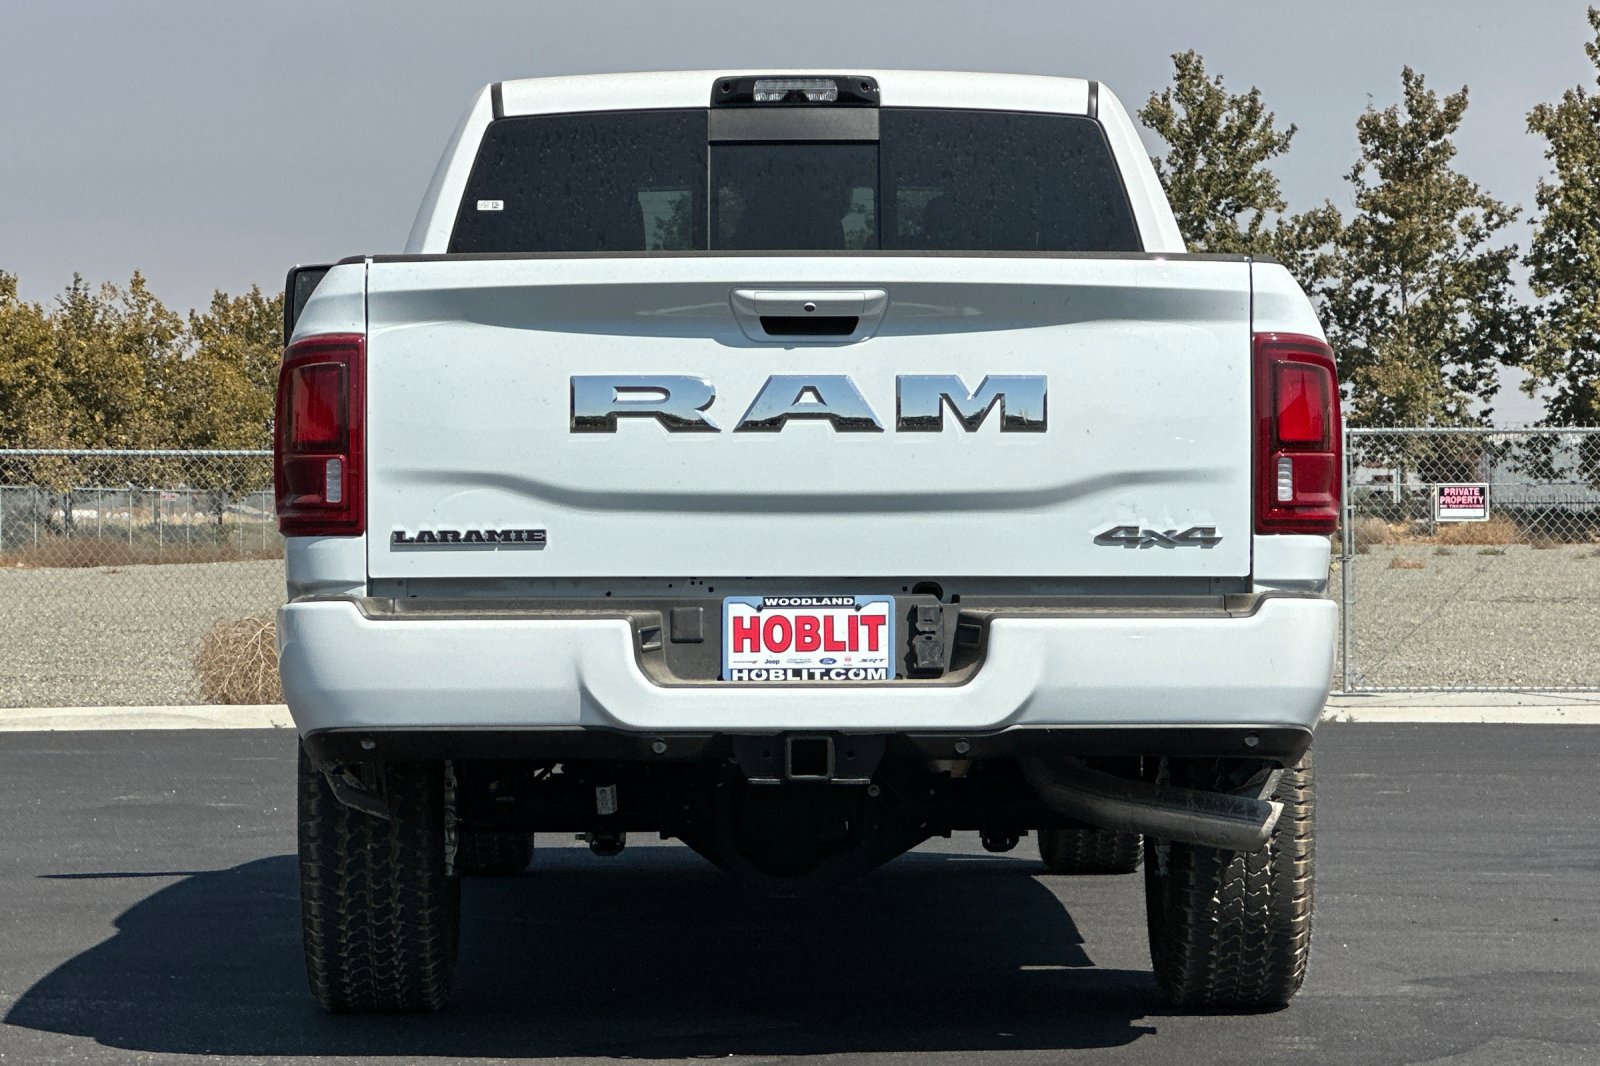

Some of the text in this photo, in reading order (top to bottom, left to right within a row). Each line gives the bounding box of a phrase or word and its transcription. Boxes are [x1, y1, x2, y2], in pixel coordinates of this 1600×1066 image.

[570, 374, 1047, 433] RAM
[1444, 487, 1480, 495] PRIVATE
[1440, 496, 1484, 504] PROPERTY
[391, 529, 547, 547] LARAMIE
[764, 597, 854, 607] WOODLAND
[733, 615, 886, 653] HOBLIT
[732, 668, 887, 681] HOBLIT.COM
